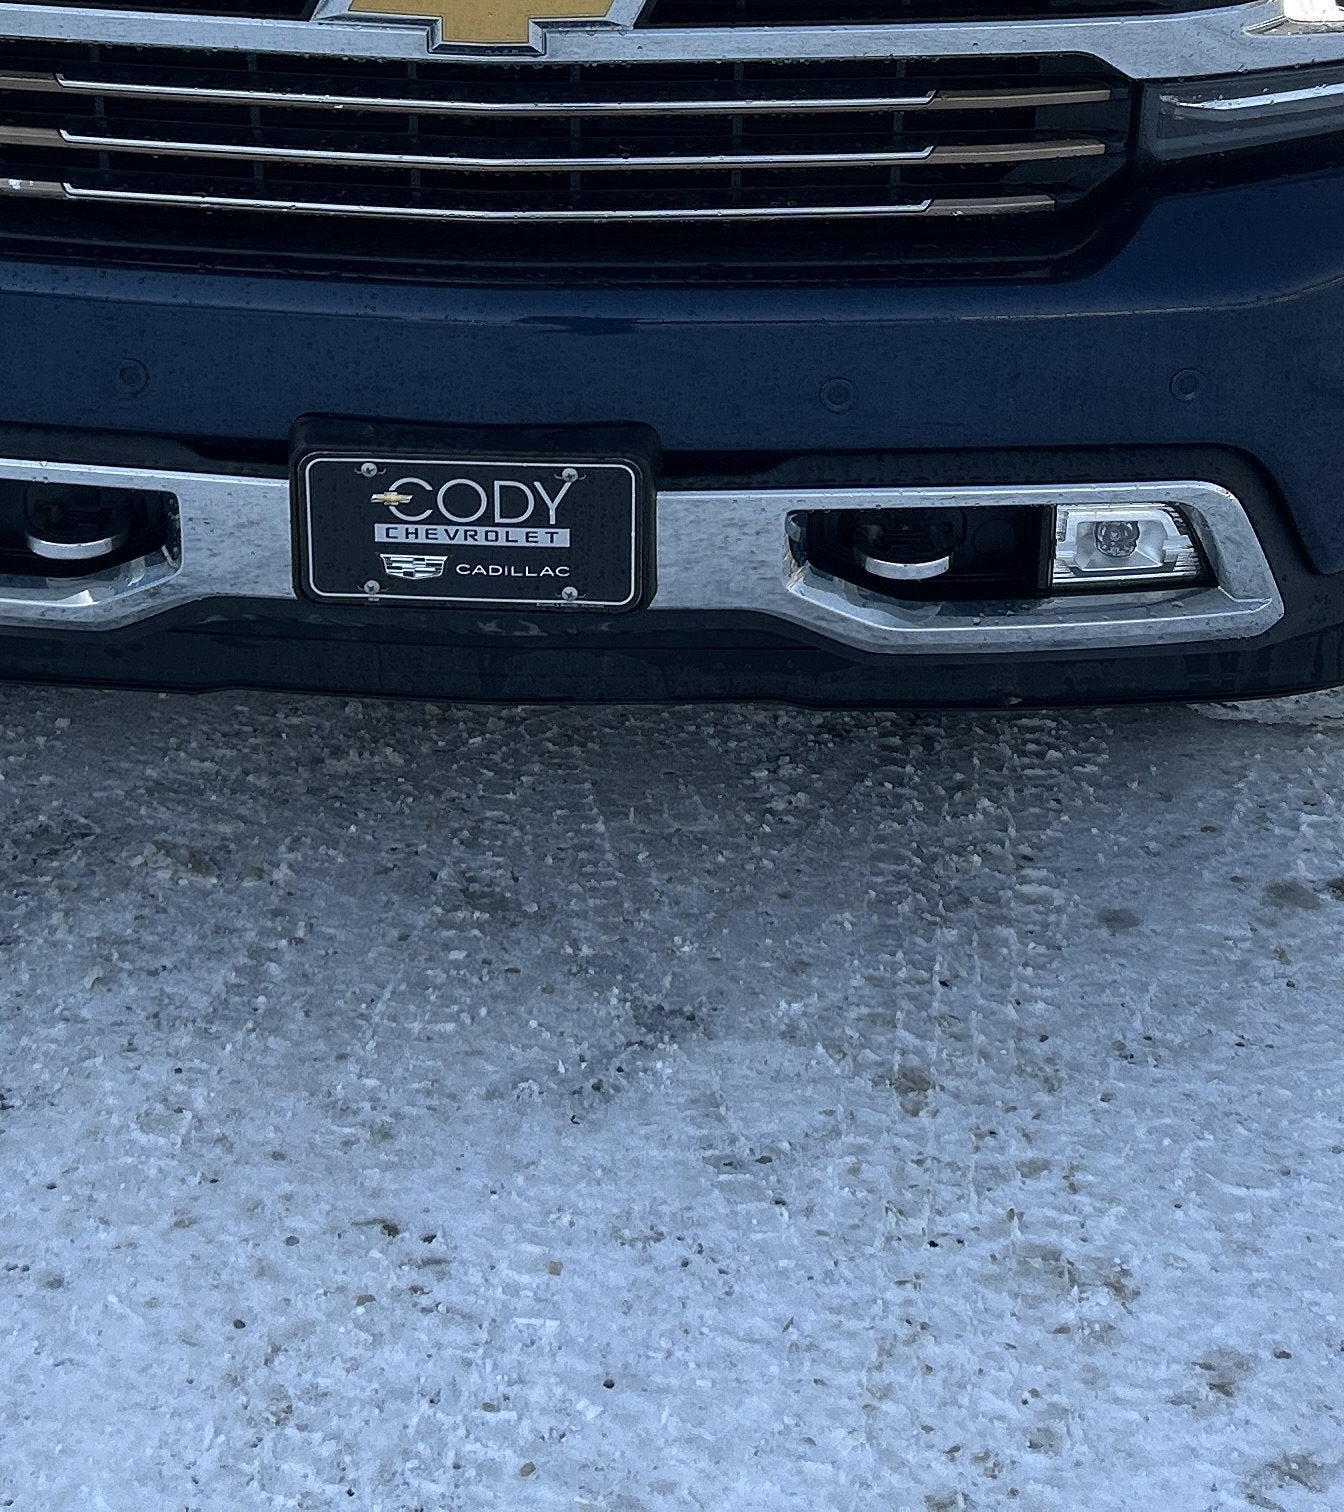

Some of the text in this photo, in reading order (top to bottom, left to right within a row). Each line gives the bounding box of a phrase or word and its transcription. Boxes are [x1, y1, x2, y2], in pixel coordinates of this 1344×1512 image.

[386, 477, 572, 525] CODY
[385, 526, 560, 544] CHEVROLET
[456, 563, 570, 578] CADILLAC
